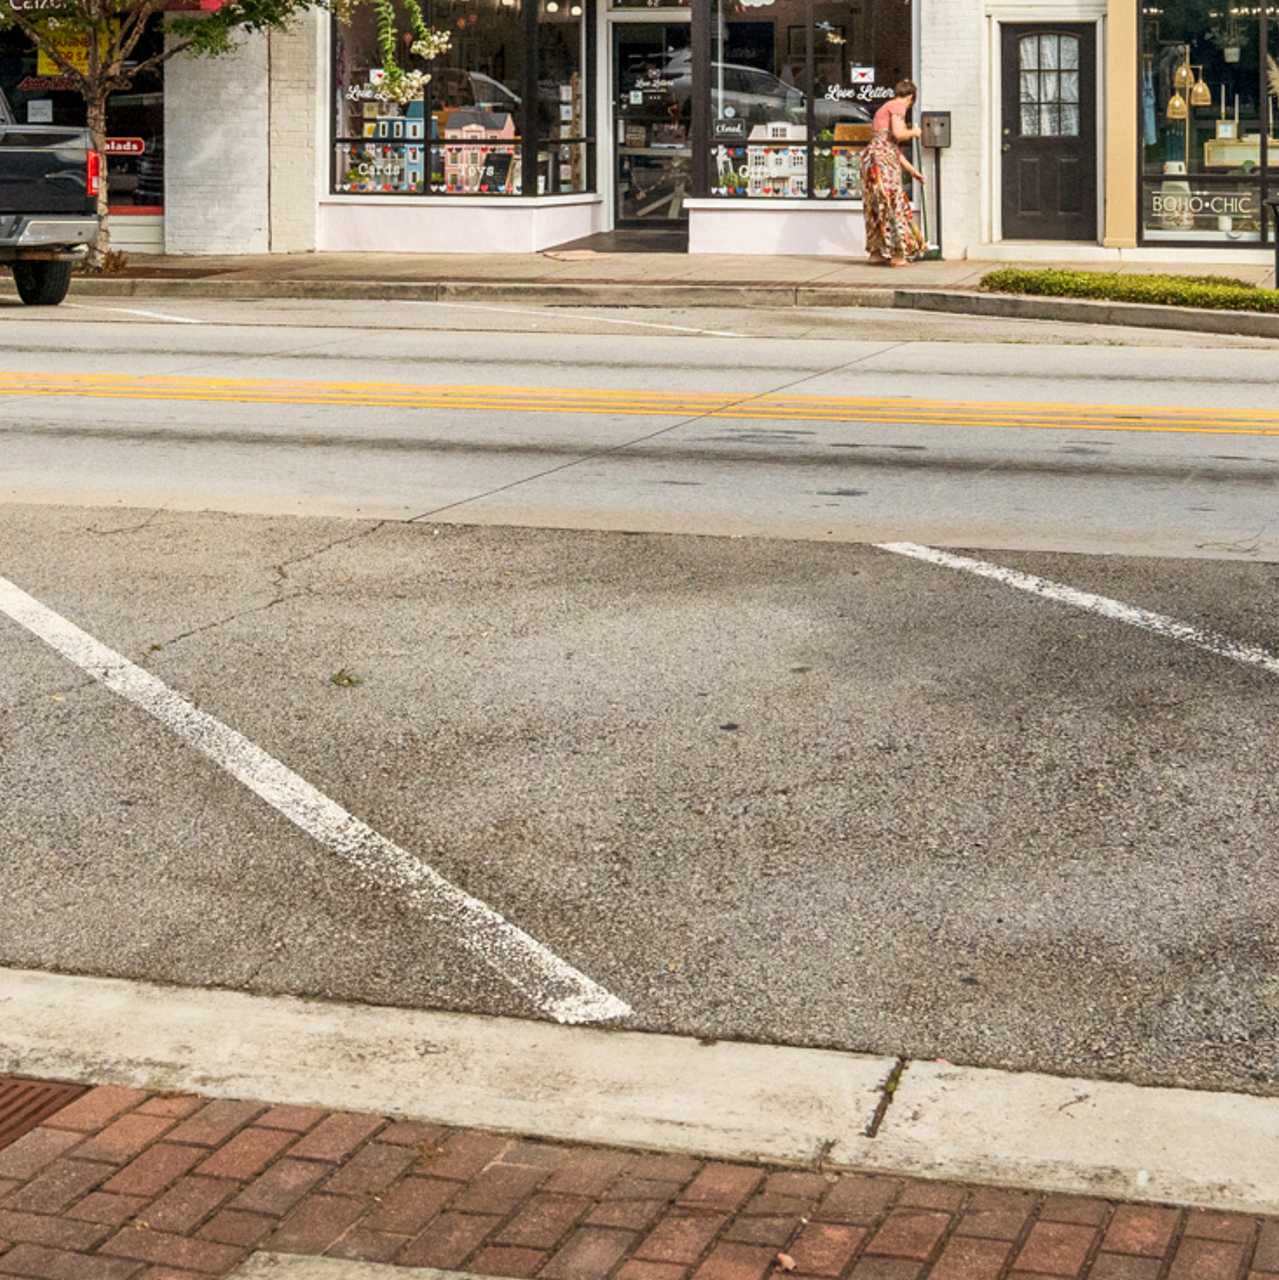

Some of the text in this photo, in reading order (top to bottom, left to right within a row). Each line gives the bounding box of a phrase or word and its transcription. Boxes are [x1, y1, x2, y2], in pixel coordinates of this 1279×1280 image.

[824, 84, 896, 102] Love Letter
[103, 140, 138, 151] alads
[358, 162, 400, 176] Cards
